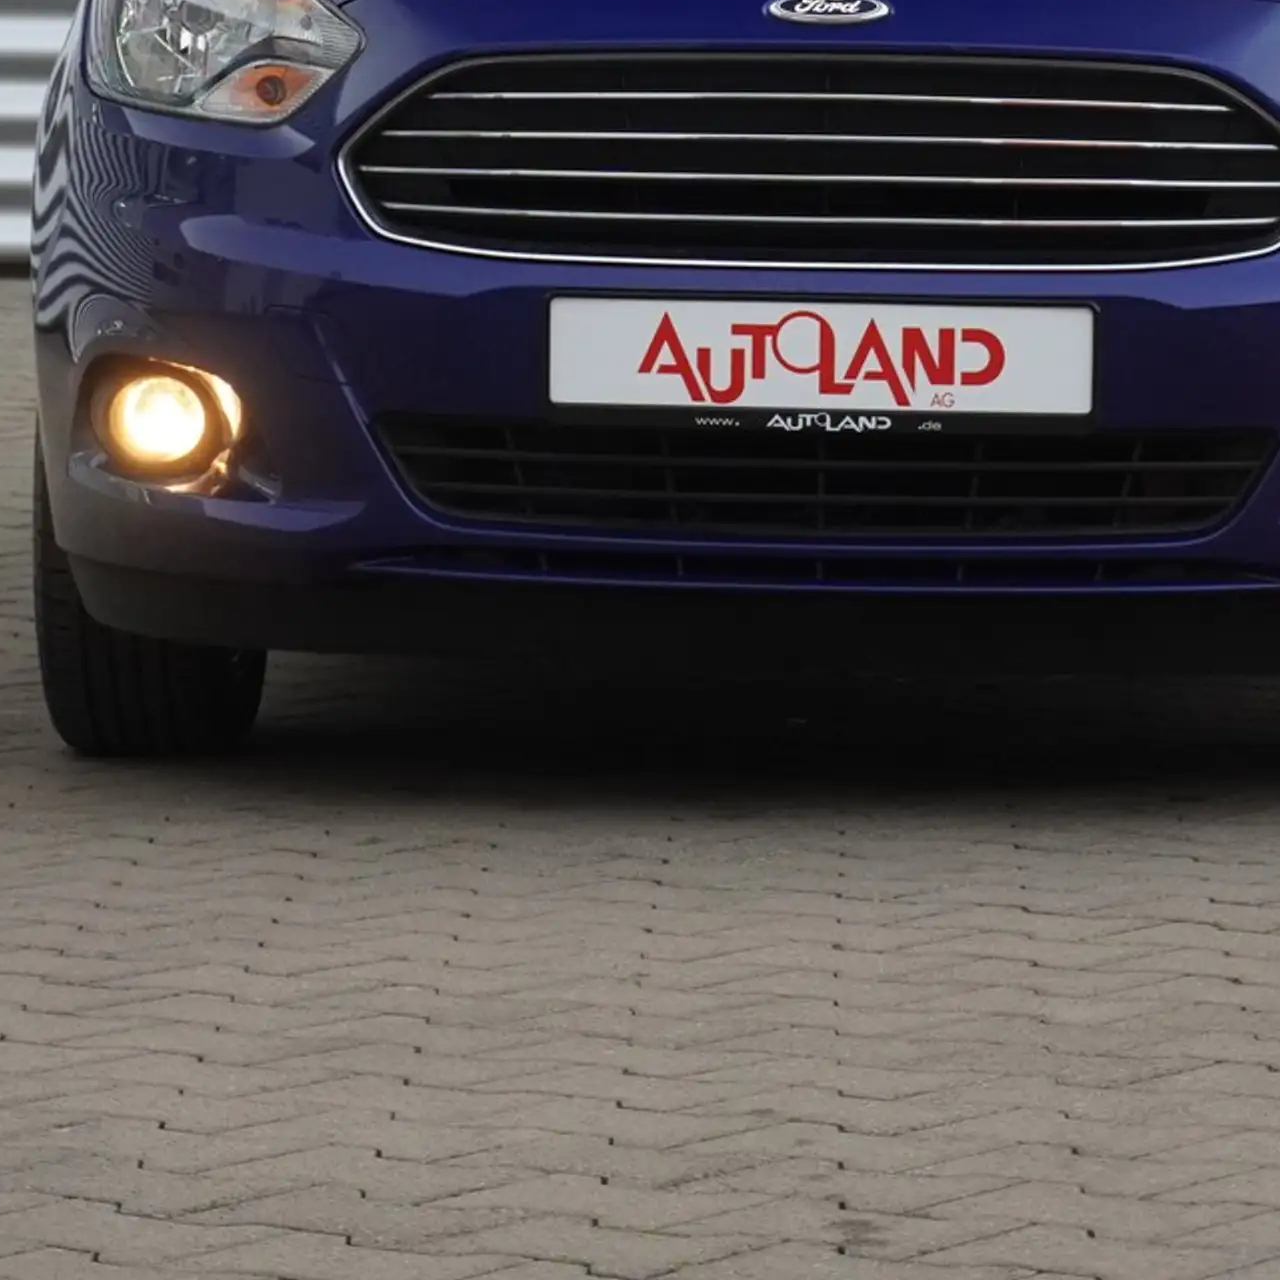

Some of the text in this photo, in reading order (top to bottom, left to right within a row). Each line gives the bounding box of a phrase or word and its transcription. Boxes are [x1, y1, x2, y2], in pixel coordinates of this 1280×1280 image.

[637, 310, 1006, 408] AUTOLAND
[930, 392, 956, 408] AG
[694, 416, 740, 427] www.
[766, 411, 892, 432] AUTOLAND
